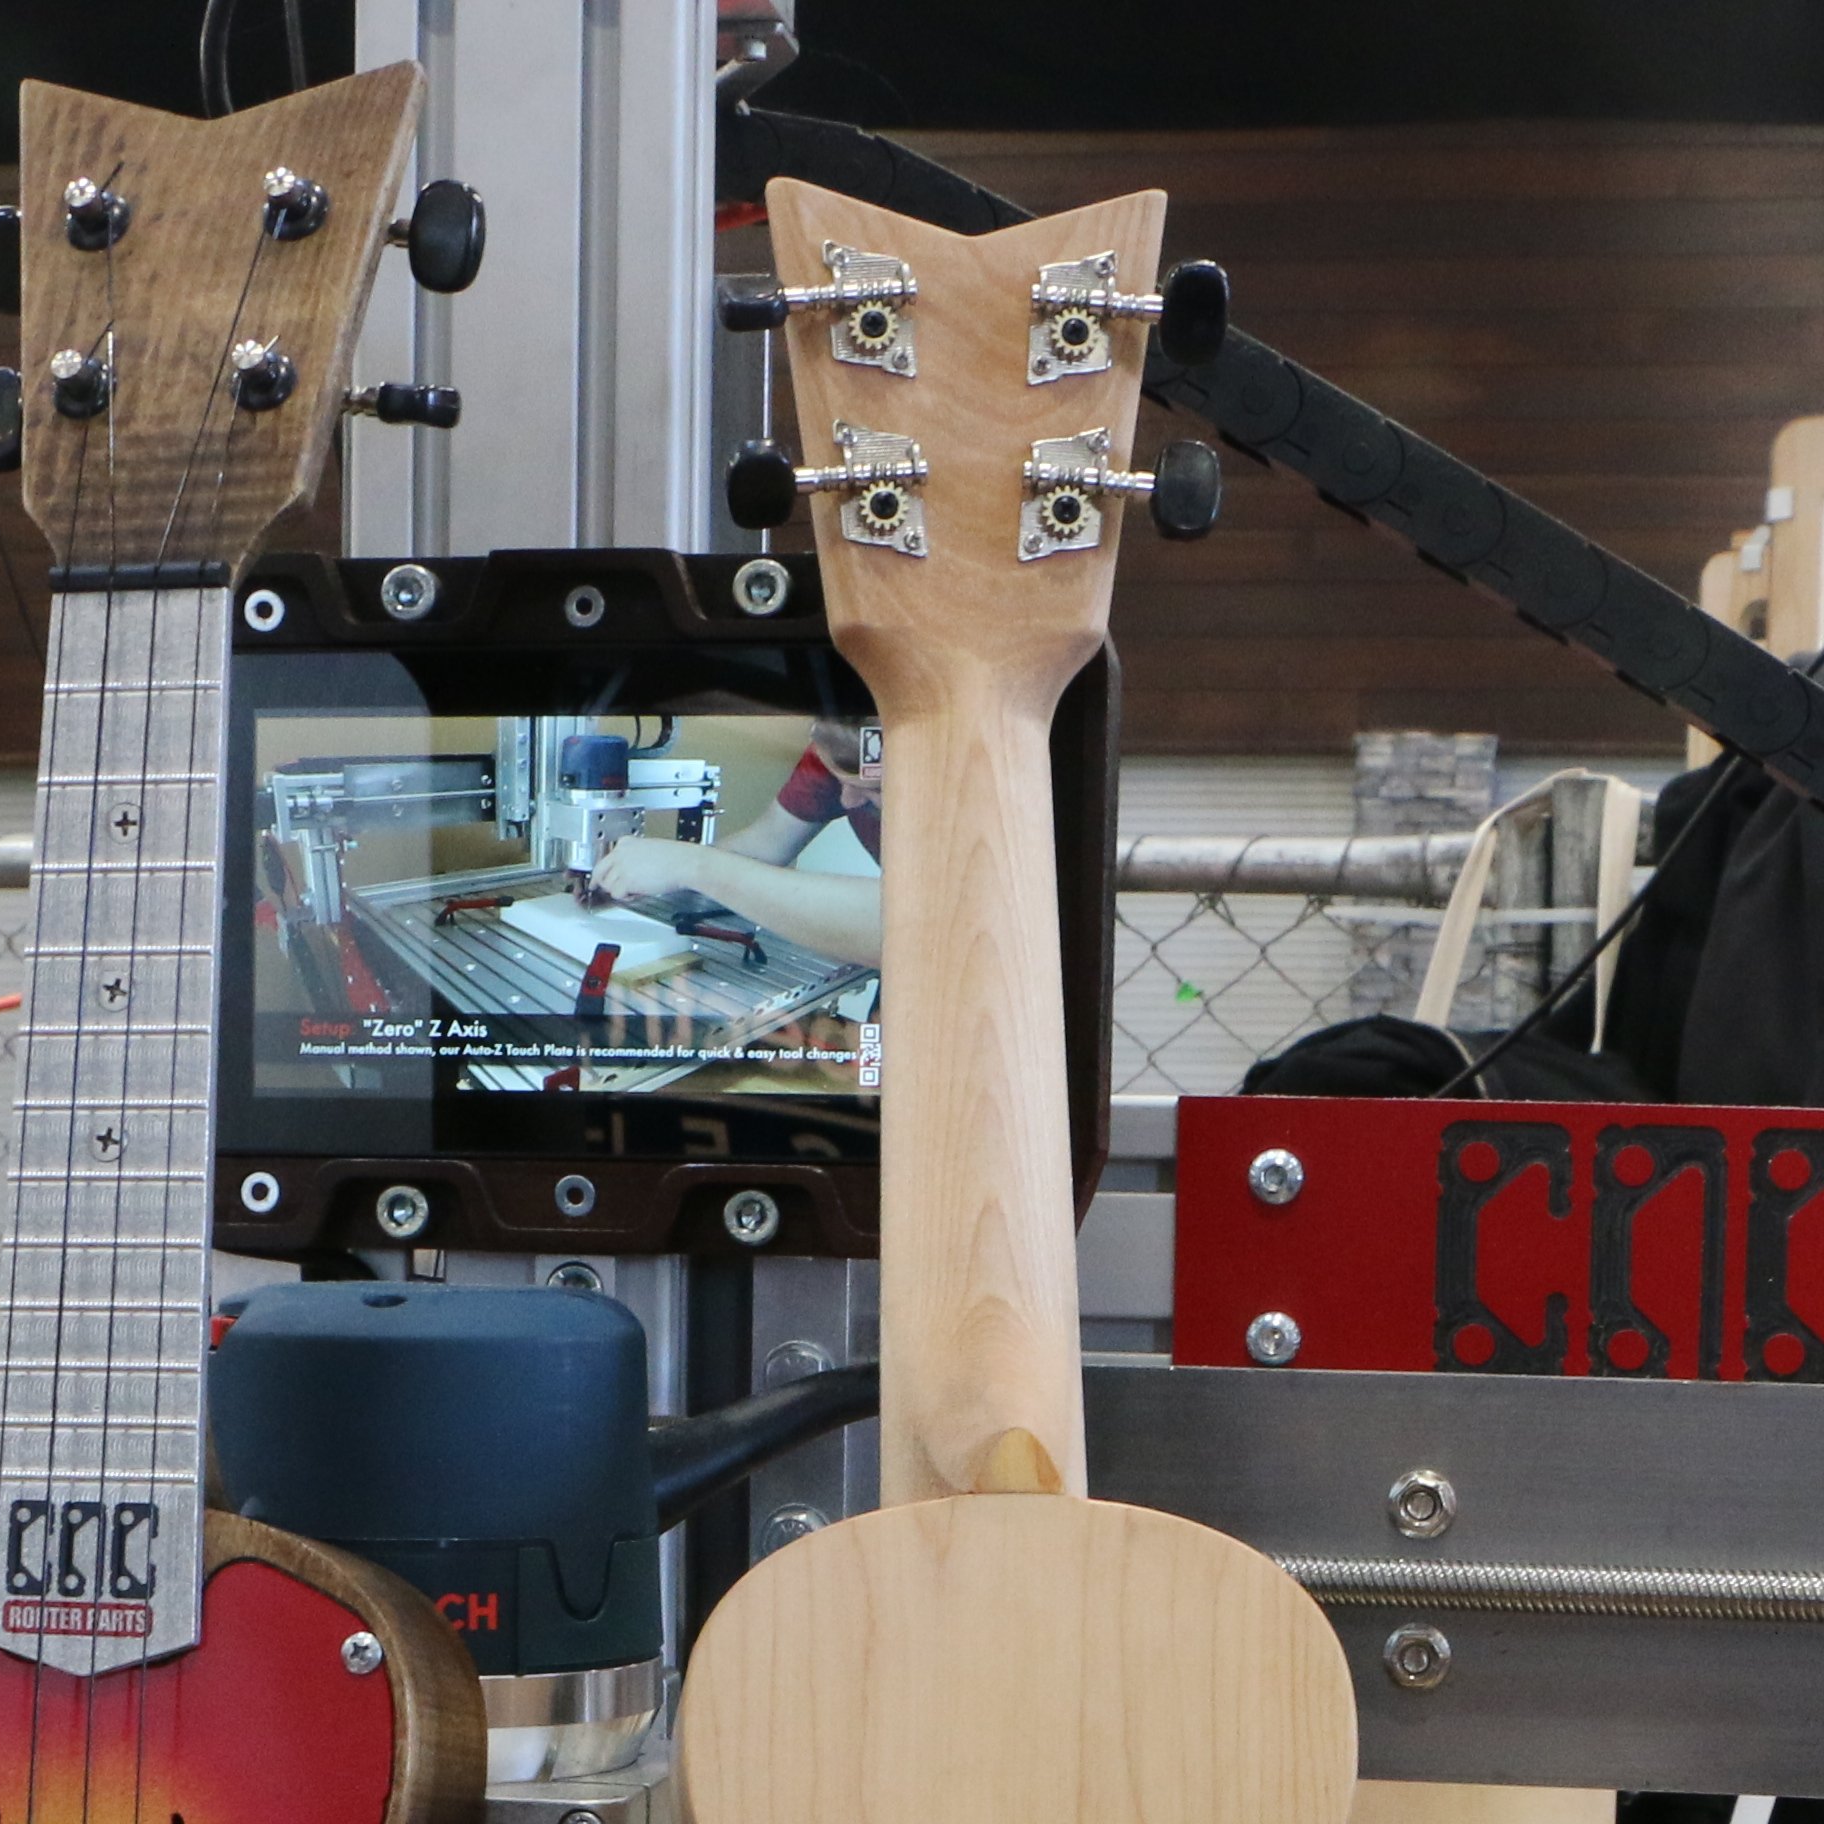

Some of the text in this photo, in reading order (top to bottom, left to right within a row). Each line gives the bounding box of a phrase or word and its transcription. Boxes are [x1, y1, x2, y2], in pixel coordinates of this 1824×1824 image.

[363, 1018, 422, 1038] "Zero"
[428, 1020, 442, 1037] Z
[446, 1019, 488, 1038] Axis
[299, 1042, 345, 1056] Manual
[347, 1042, 392, 1056] method
[394, 1042, 436, 1058] shown,
[439, 1045, 460, 1057] our
[463, 1043, 503, 1057] Auto-Z
[505, 1043, 541, 1057] Touch
[543, 1043, 574, 1058] Plate
[576, 1044, 586, 1057] is
[588, 1044, 674, 1059] recommended
[676, 1044, 696, 1059] for
[697, 1045, 731, 1062] quick
[733, 1046, 745, 1060] &
[747, 1049, 777, 1063] easy
[778, 1047, 803, 1060] tool
[8, 1605, 147, 1633] ROUTER PARTS
